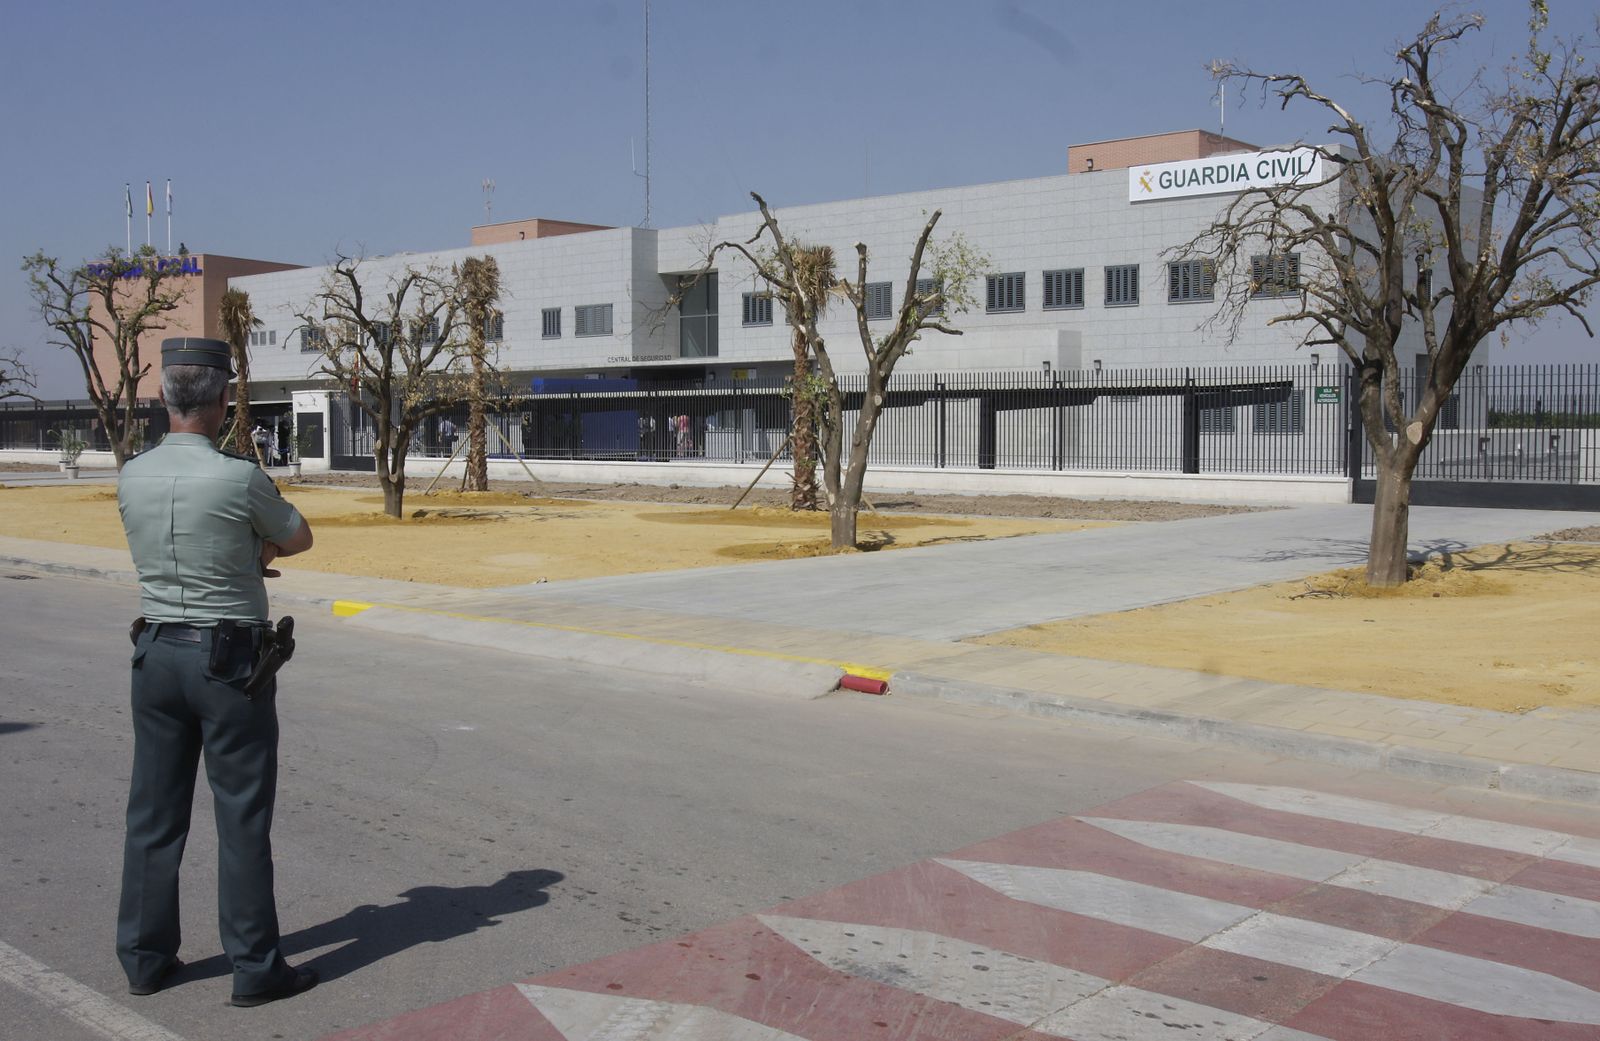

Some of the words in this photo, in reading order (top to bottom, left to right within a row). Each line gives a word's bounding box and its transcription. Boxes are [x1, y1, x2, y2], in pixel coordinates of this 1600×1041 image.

[1159, 162, 1250, 189] GUARDIA
[1256, 156, 1307, 179] CIVIL
[87, 261, 143, 279] POCIA
[607, 355, 631, 363] CENTRAL
[640, 354, 672, 362] SEGURIDAD
